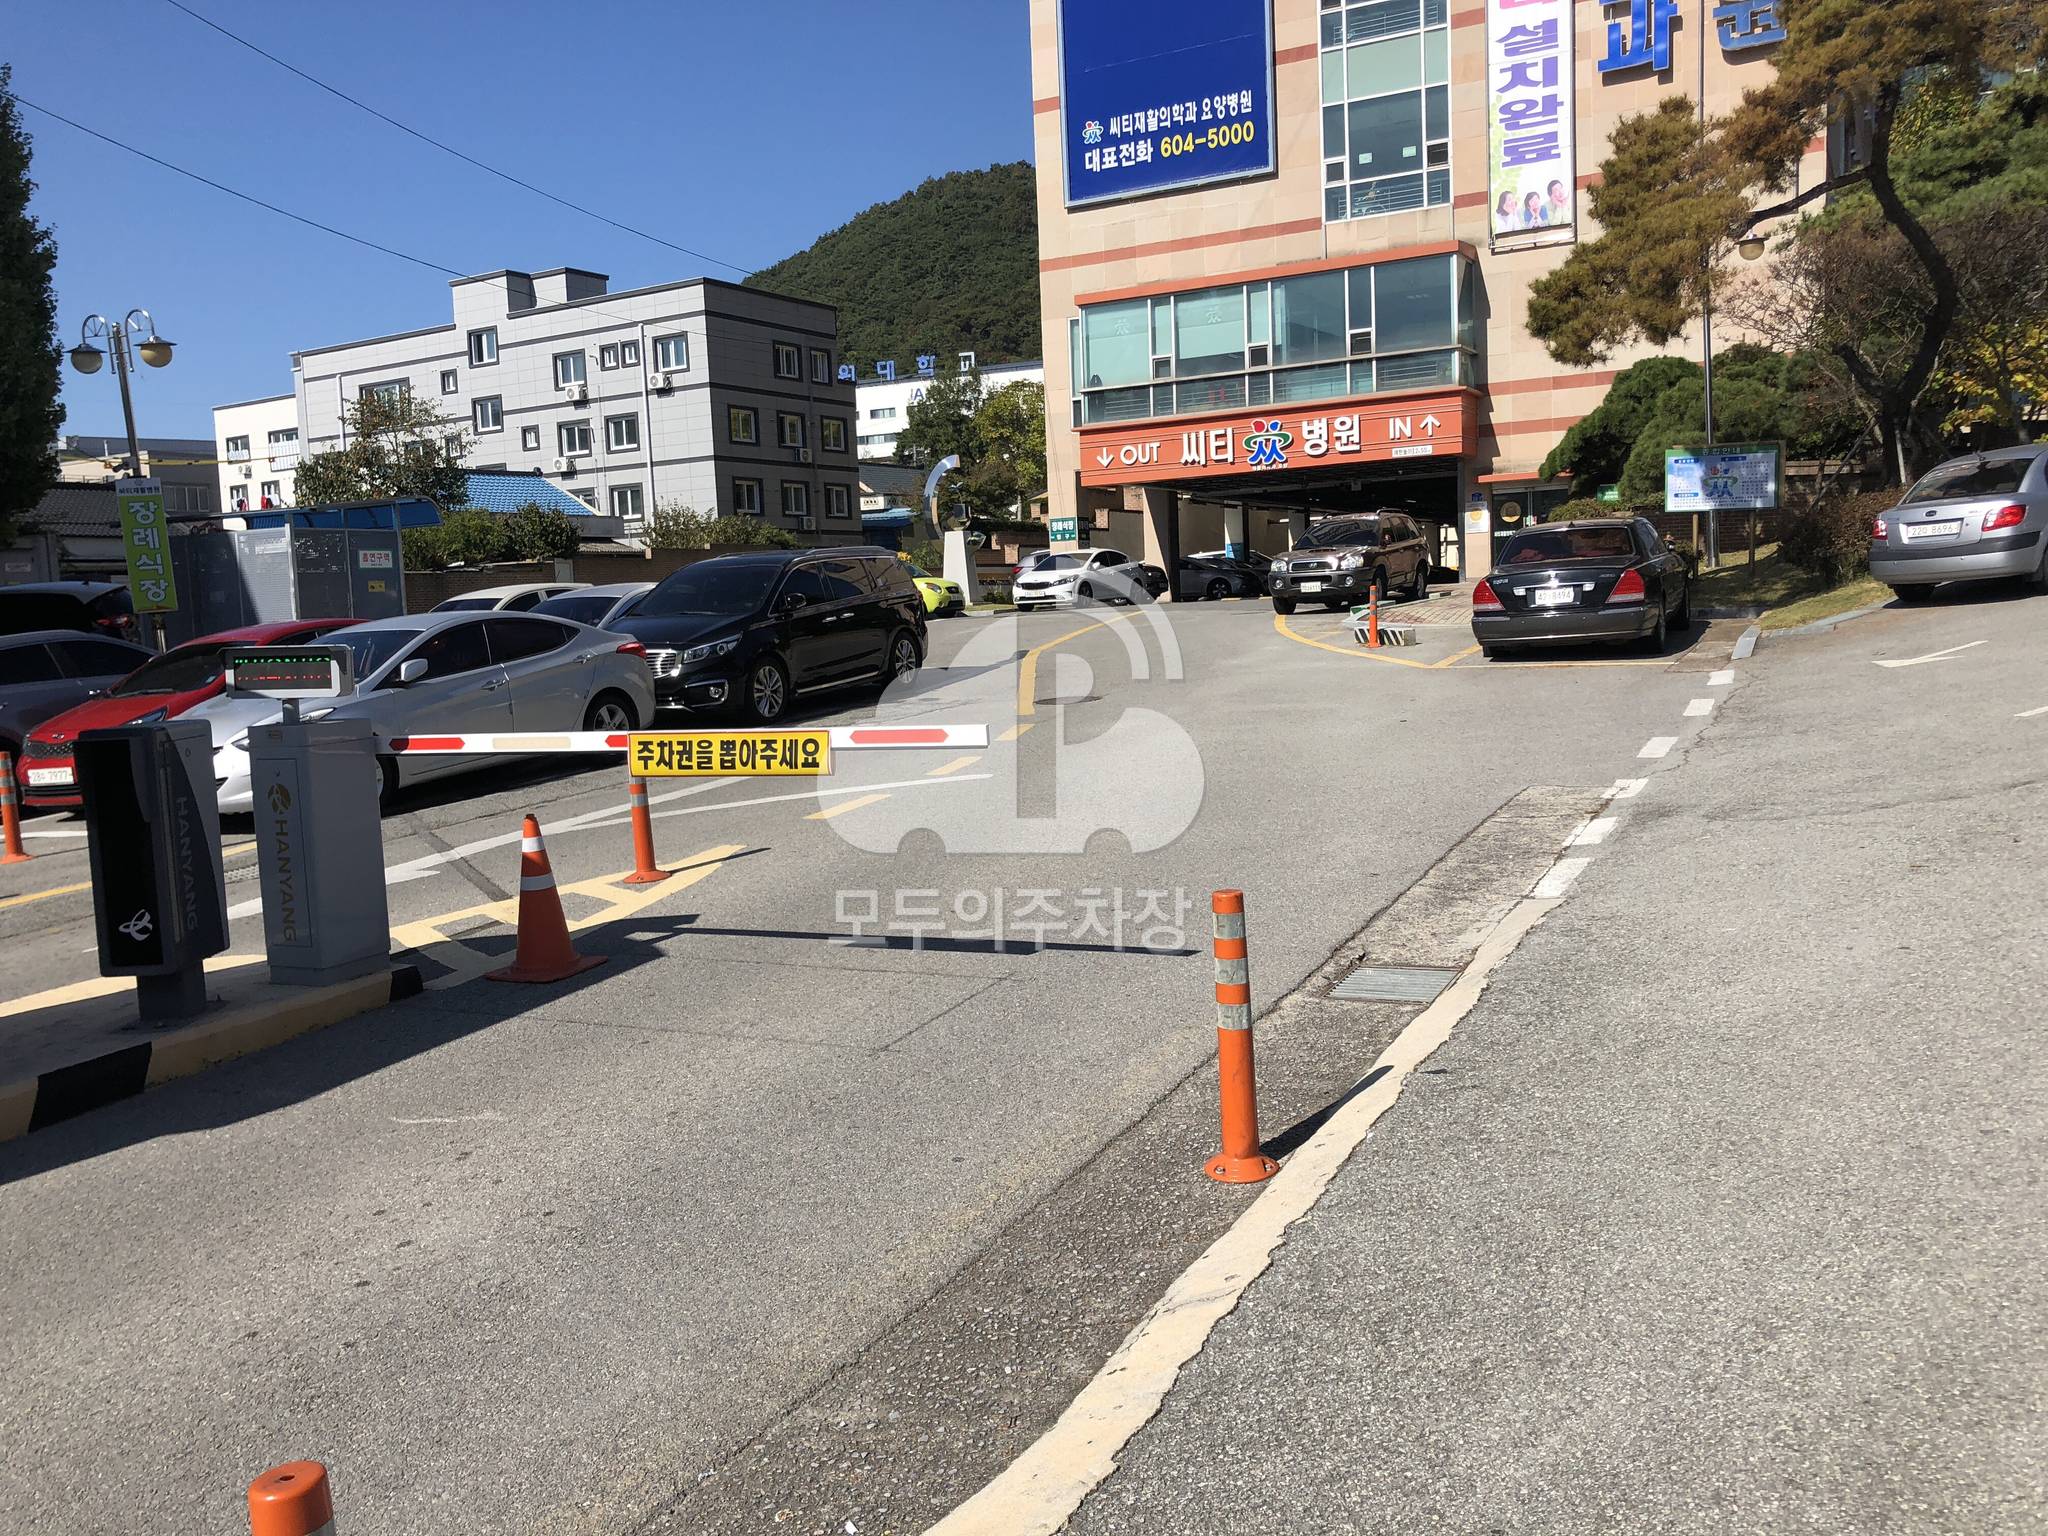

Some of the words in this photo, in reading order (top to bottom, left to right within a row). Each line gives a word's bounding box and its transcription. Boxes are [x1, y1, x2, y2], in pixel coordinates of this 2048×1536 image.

[1109, 101, 1197, 138] 씨티재활의학과
[1201, 90, 1252, 121] 요양병원
[1495, 18, 1565, 168] 설치완료
[1084, 138, 1154, 173] 대표전화
[1160, 120, 1255, 158] 604-5000
[1120, 442, 1161, 466] OUT
[1180, 427, 1233, 467] 씨티
[1302, 414, 1361, 456] 병원
[1388, 415, 1413, 440] IN
[128, 501, 169, 602] 장례식장
[1051, 520, 1074, 531] 장례식장
[637, 739, 714, 770] 주차권을
[719, 738, 820, 770] 뽑아주세요
[176, 796, 199, 931] HANYANG
[274, 819, 297, 942] HANYANG
